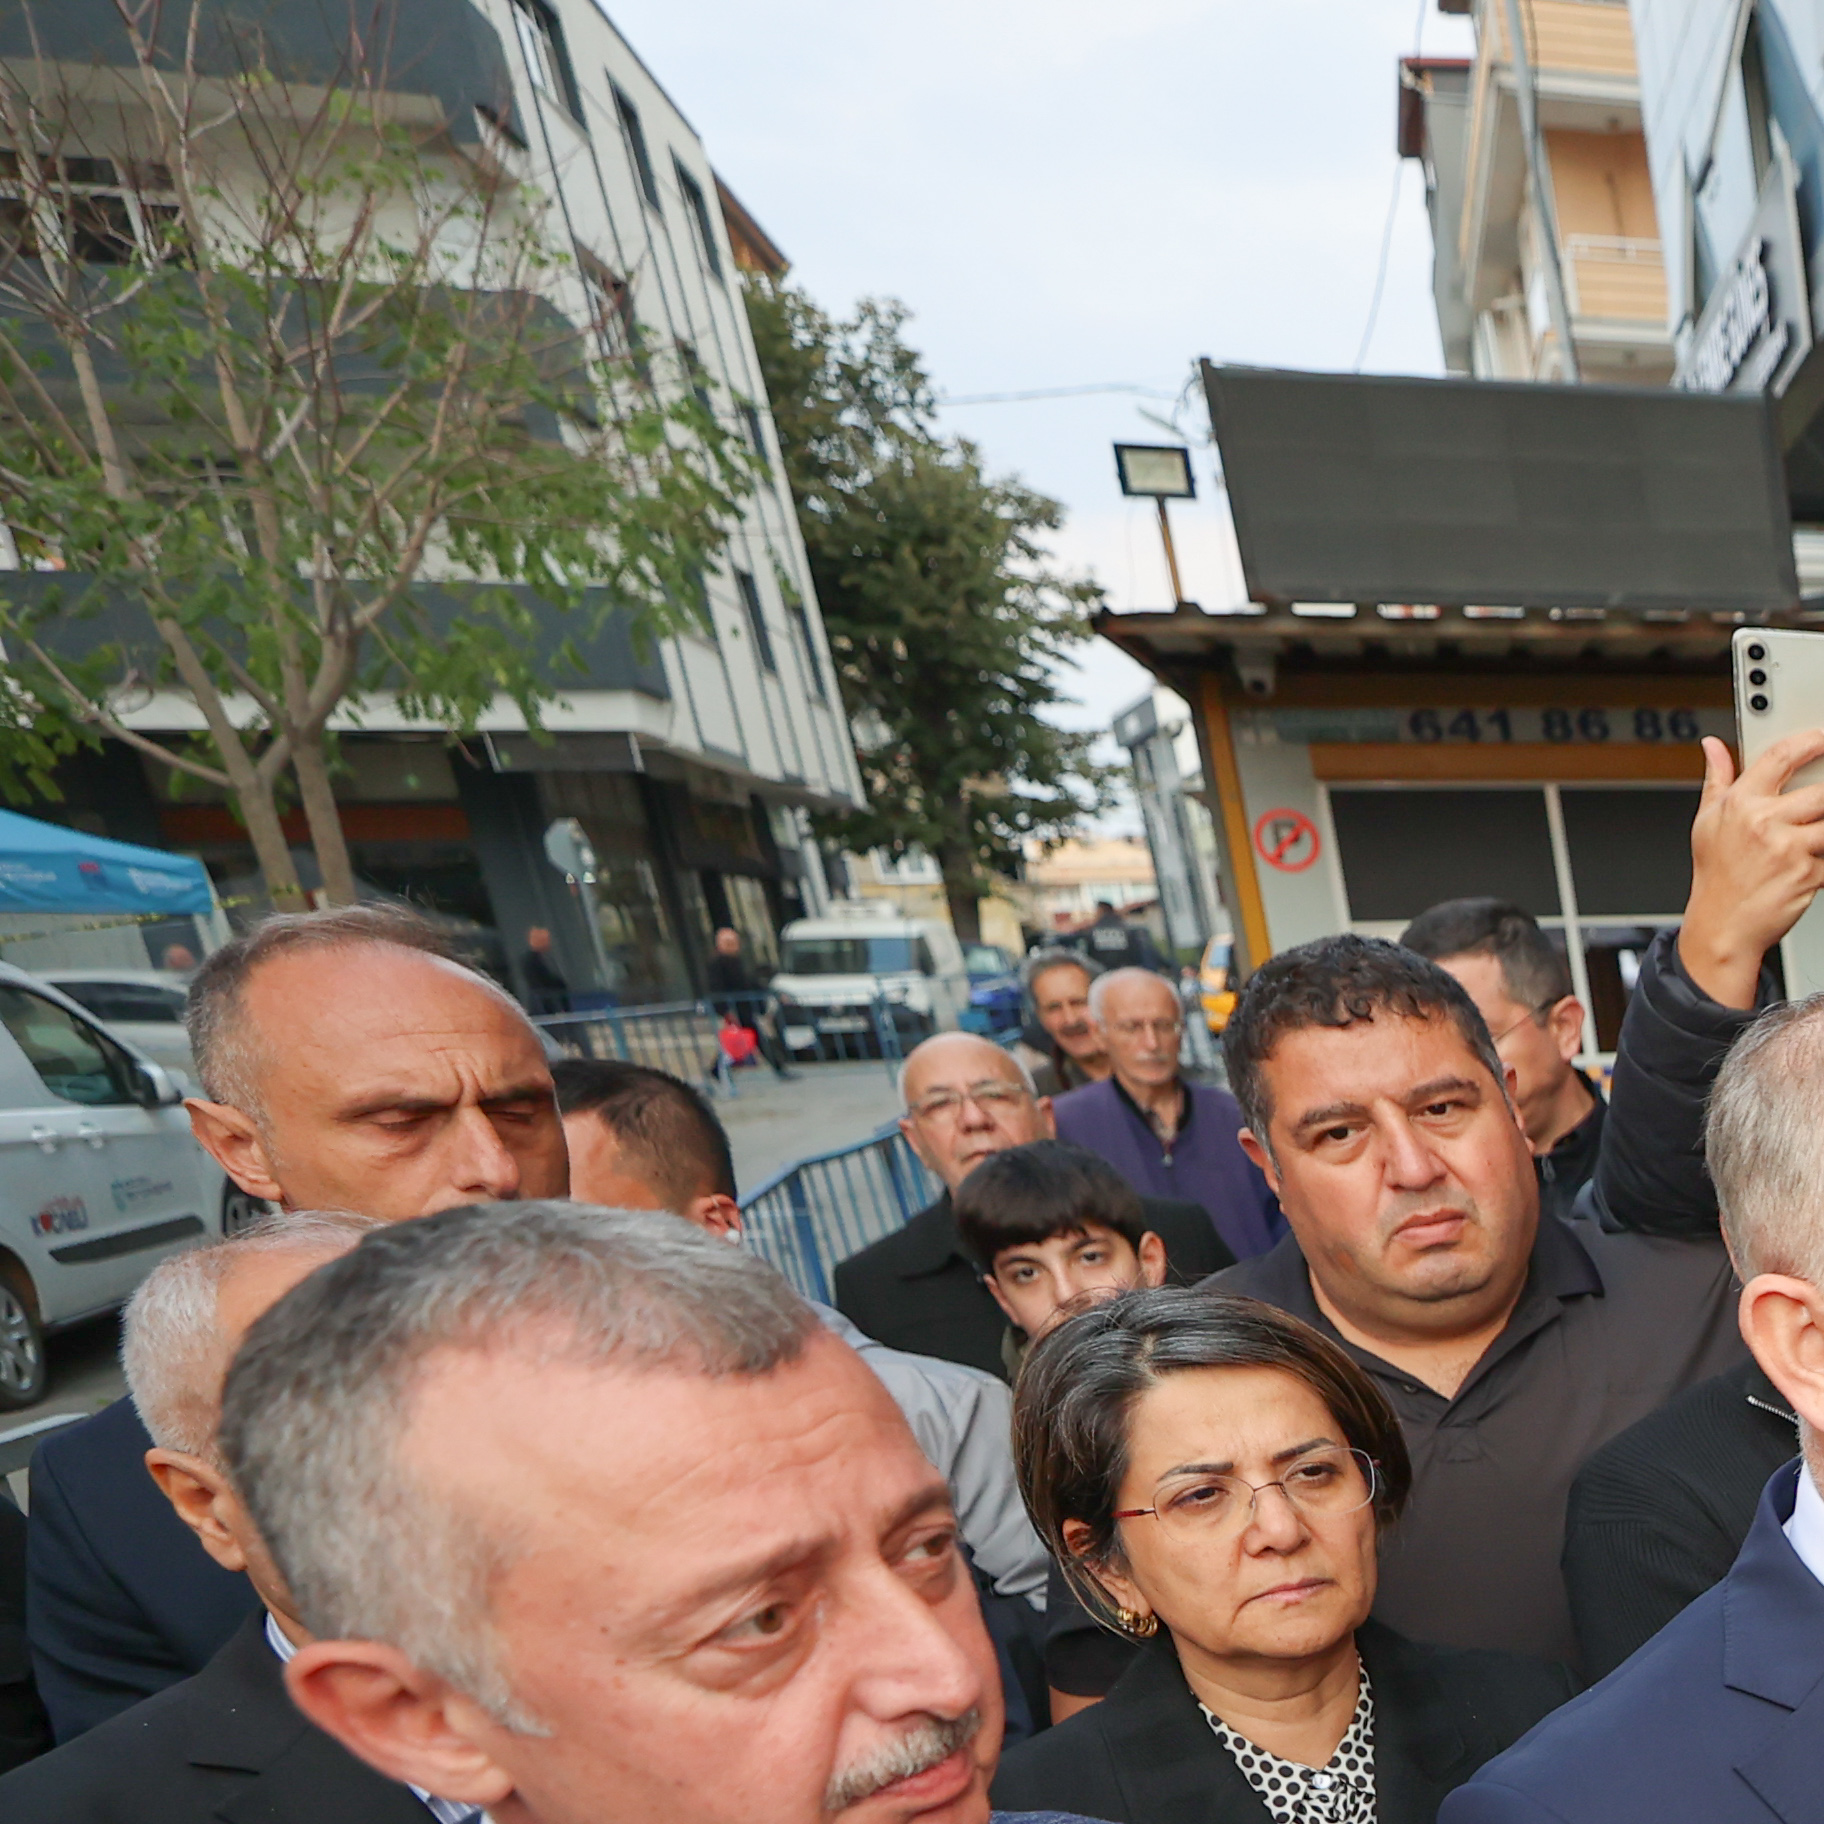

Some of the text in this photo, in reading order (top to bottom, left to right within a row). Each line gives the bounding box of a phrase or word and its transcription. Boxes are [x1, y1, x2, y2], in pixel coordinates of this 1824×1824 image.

[1408, 707, 1513, 743] 641
[1540, 707, 1610, 743] 86
[1633, 707, 1699, 743] 86
